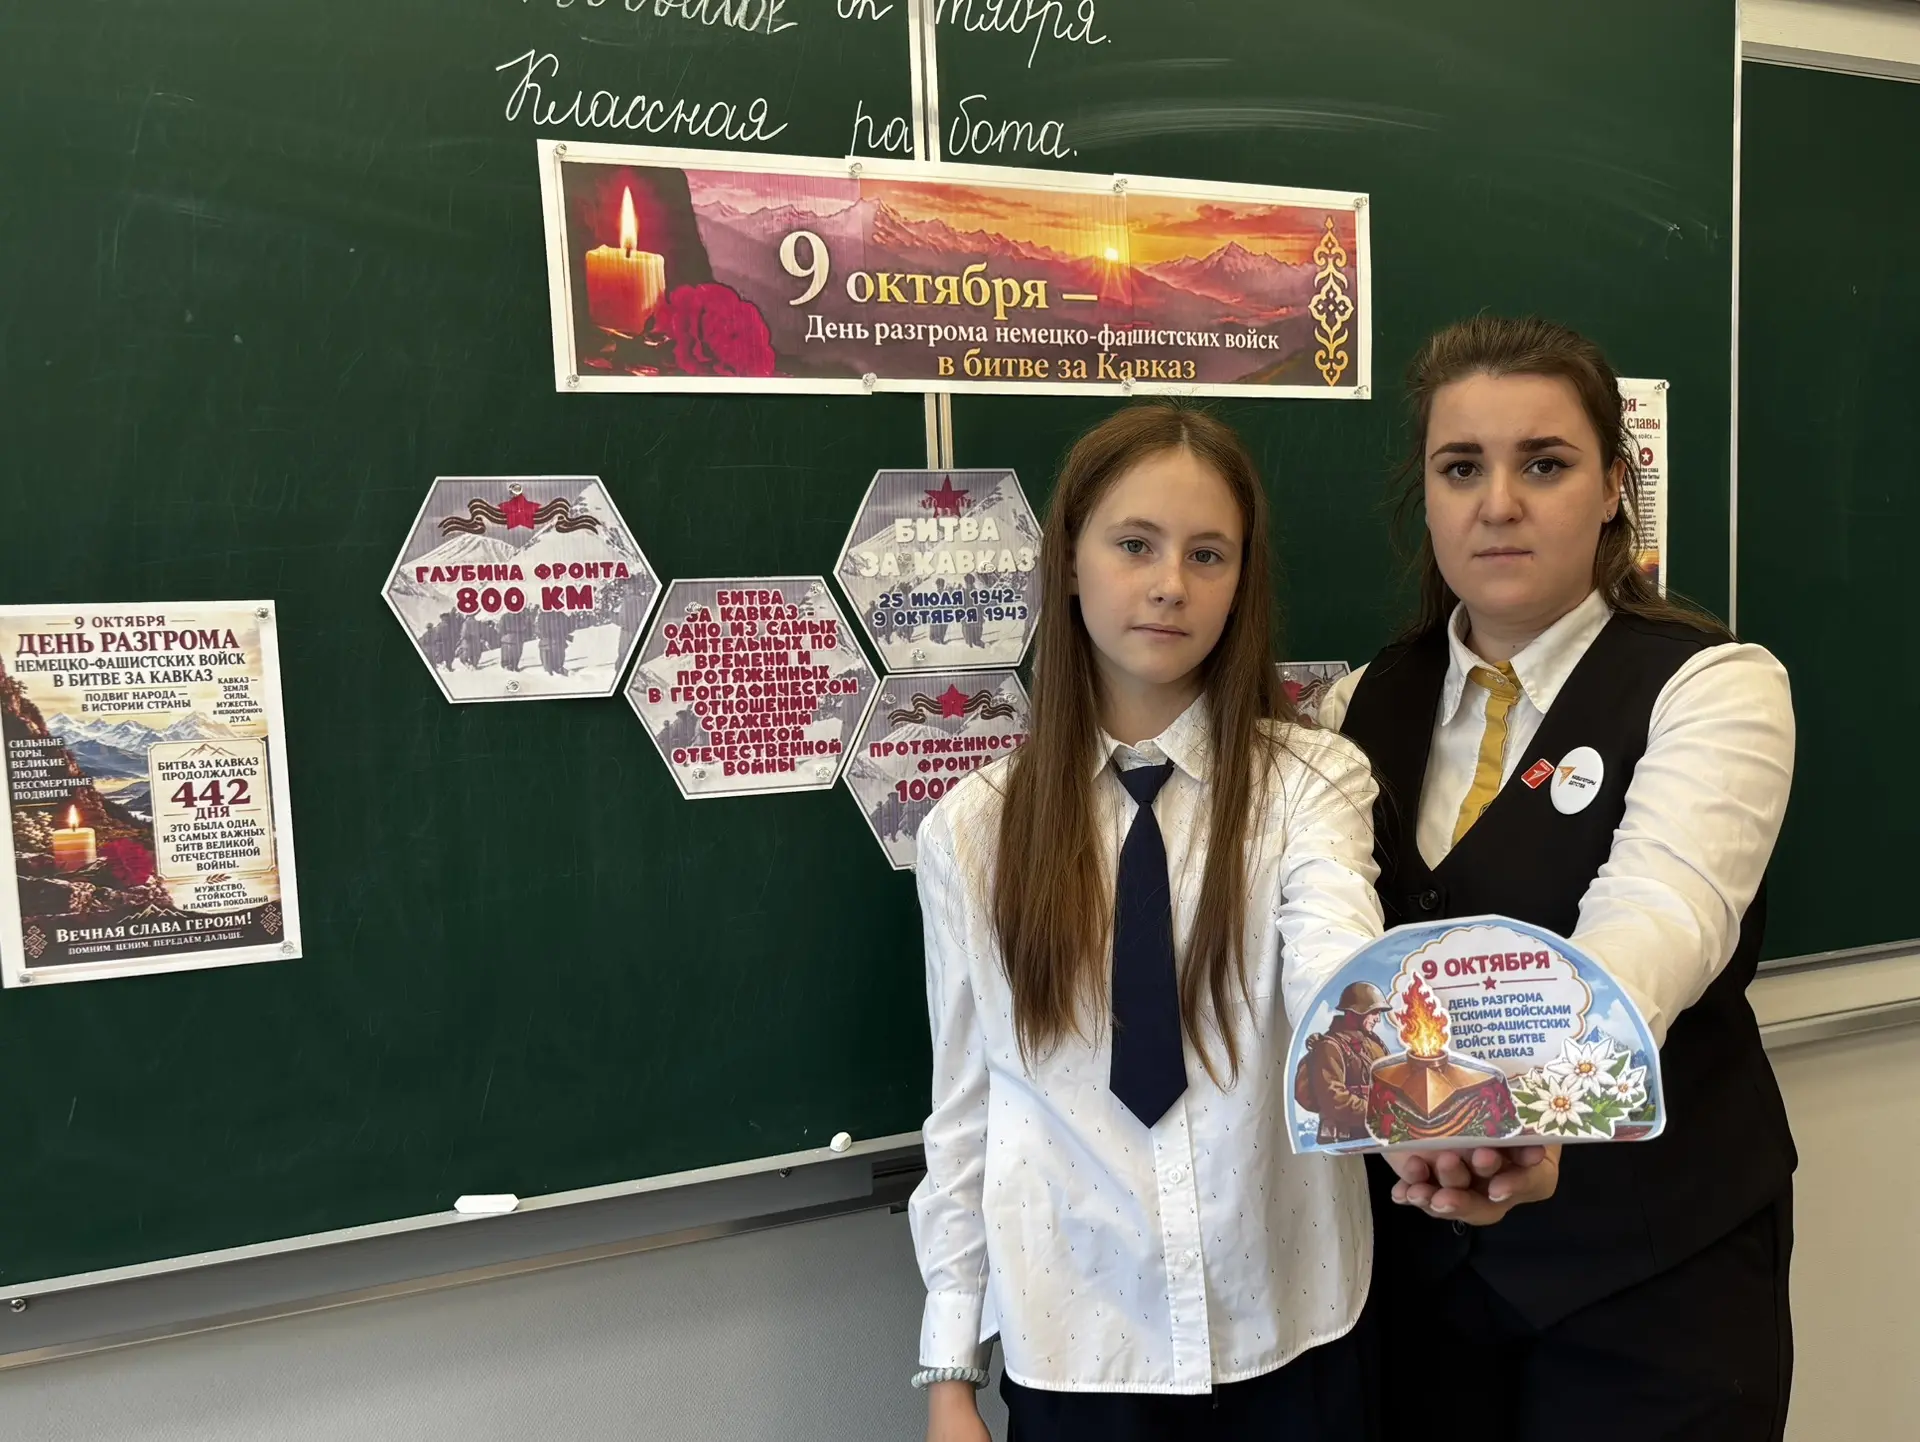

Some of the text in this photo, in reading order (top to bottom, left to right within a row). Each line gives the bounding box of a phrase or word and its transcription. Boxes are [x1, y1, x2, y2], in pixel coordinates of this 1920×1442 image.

[496, 49, 787, 140] Классная
[779, 231, 830, 306] 9
[845, 262, 1049, 321] октября
[806, 315, 1280, 351] День разгрома немецко-фашистских войск
[938, 349, 1195, 380] в битве за Кавказ
[895, 517, 1000, 543] БИТВА
[860, 548, 1036, 577] ЗА КАВКАЗ
[416, 562, 629, 583] ГЛУБИНА ФРОНТА
[457, 585, 594, 613] 800 КМ
[717, 590, 783, 605] БИТВА
[879, 589, 1022, 608] 25 ИЮЛЯ 1942-
[720, 605, 798, 621] КАВКАЗ
[874, 607, 1028, 626] 9 ОКТЯБРЯ 1943
[74, 616, 165, 629] 9 ОКТЯБРЯ
[664, 620, 836, 640] ОДНО ИЗ САМЫХ
[16, 629, 240, 657] ДЕНЬ РАЗГРОМА
[665, 635, 836, 657] ДЛИТЕЛЬНЫХ ПО
[15, 653, 245, 673] НЕМЕЦКО-ФАШИСТСКИХ ВОЙСК
[695, 651, 811, 669] ВРЕМЕНИ И
[53, 669, 213, 687] В БИТВЕ ЗА КАВКАЗ
[677, 665, 829, 685] ПРОТЯЖЁННЫХ
[85, 692, 129, 702] ПОДВИГ
[133, 691, 176, 701] НАРОДА
[649, 680, 857, 703] В ГЕОГРАФИЧЕСКОМ
[82, 700, 191, 712] В ИСТОРИИ СТРАНЫ
[694, 696, 817, 715] ОТНОШЕНИИ
[701, 711, 812, 730] СРАЖЕНИЙ
[9, 738, 63, 749] СИЛЬНЫЕ
[711, 728, 804, 746] ВЕЛИКОЙ
[673, 740, 841, 763] ОТЕЧЕСТВЕННОЙ
[12, 758, 65, 769] ВЕЛИКИЕ
[158, 757, 259, 771] БИТВА ЗА КАВКАЗ
[724, 759, 795, 776] ВОЙНЫ
[162, 768, 257, 780] ПРОДОЛЖАЛАСЬ
[14, 779, 91, 789] БЕССМЕРТНЫЕ
[171, 778, 251, 809] 442
[195, 807, 230, 820] ДНЯ
[170, 819, 256, 832] ЭТО БЫЛА ОДНА
[163, 828, 265, 843] ИЗ САМЫХ ВАЖНЫХ
[176, 838, 255, 852] БИТВ ВЕЛИКОЙ
[172, 848, 260, 862] ОТЕЧЕСТВЕННОЙ
[196, 861, 239, 872] ВОЙНЫ.
[190, 900, 221, 909] ПАМЯТЬ
[224, 895, 268, 907] ПОКОЛЕНИЙ
[196, 890, 247, 901] СТОЙКОСТЬ
[128, 922, 181, 937] СЛАВА
[186, 911, 252, 930] ГЕРОЯМ!
[1422, 951, 1550, 979] 9 ОКТЯБРЯ
[1449, 993, 1543, 1010] ДЕНЬ РАЗГРОМА
[1505, 1005, 1571, 1016] ВОЙСКАМИ
[1452, 1019, 1570, 1036] ЕЦКО-ФАШИСТСКИХ
[1456, 1033, 1545, 1049] ВОЙСК В БИТВЕ
[1488, 1047, 1534, 1058] КАВКАЗ
